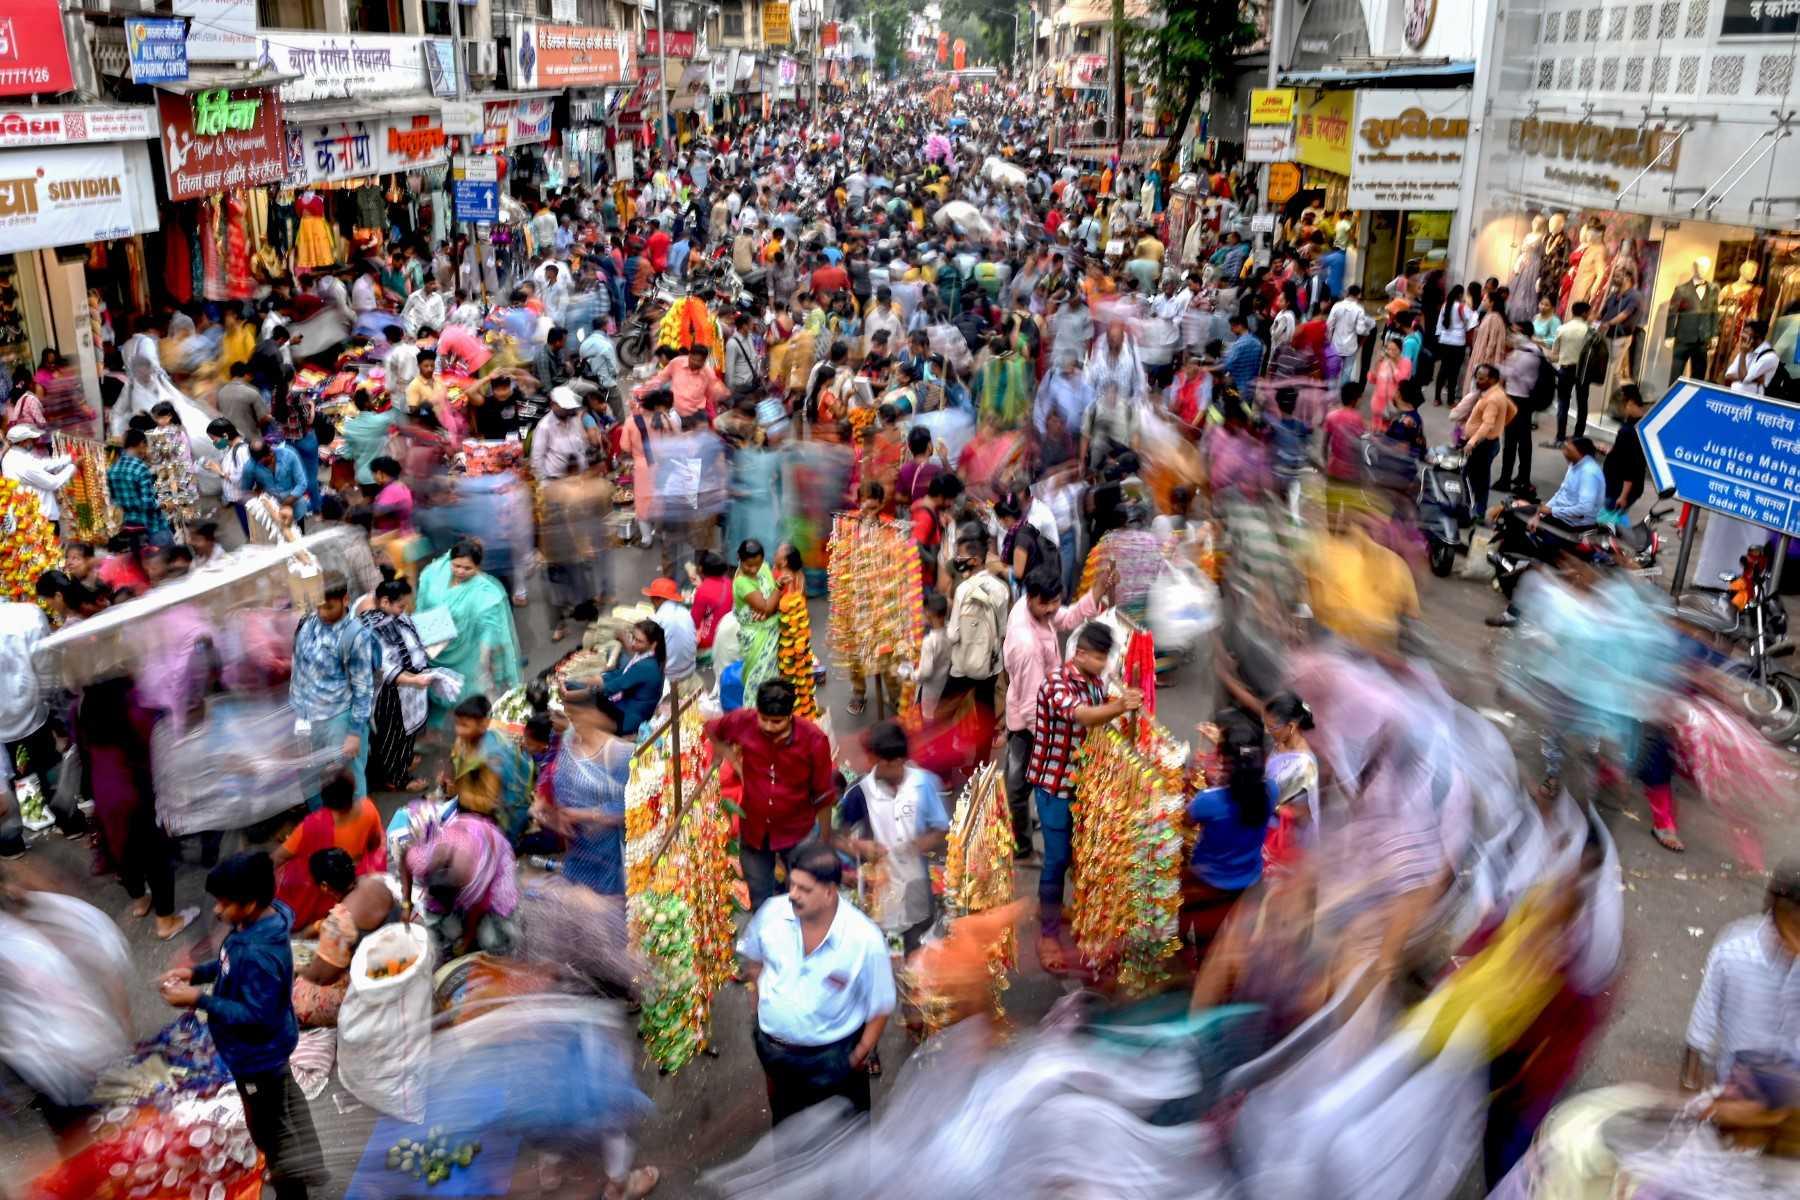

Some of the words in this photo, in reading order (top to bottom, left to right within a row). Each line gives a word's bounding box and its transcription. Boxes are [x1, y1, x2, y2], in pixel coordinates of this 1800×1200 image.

[153, 45, 176, 60] MOBILE
[648, 43, 691, 55] TTAN
[134, 63, 165, 78] REPAIRING
[1360, 108, 1470, 149] सुविधा
[194, 139, 213, 160] Bar
[223, 135, 266, 157] Restaurant
[48, 176, 122, 202] SUVIDHA
[1703, 440, 1754, 464] Justice
[1674, 446, 1721, 470] Govind
[1725, 461, 1779, 487] Ranade
[1708, 494, 1738, 511] Dadar
[1740, 504, 1759, 520] Rly.
[1762, 511, 1783, 526] Stn.
